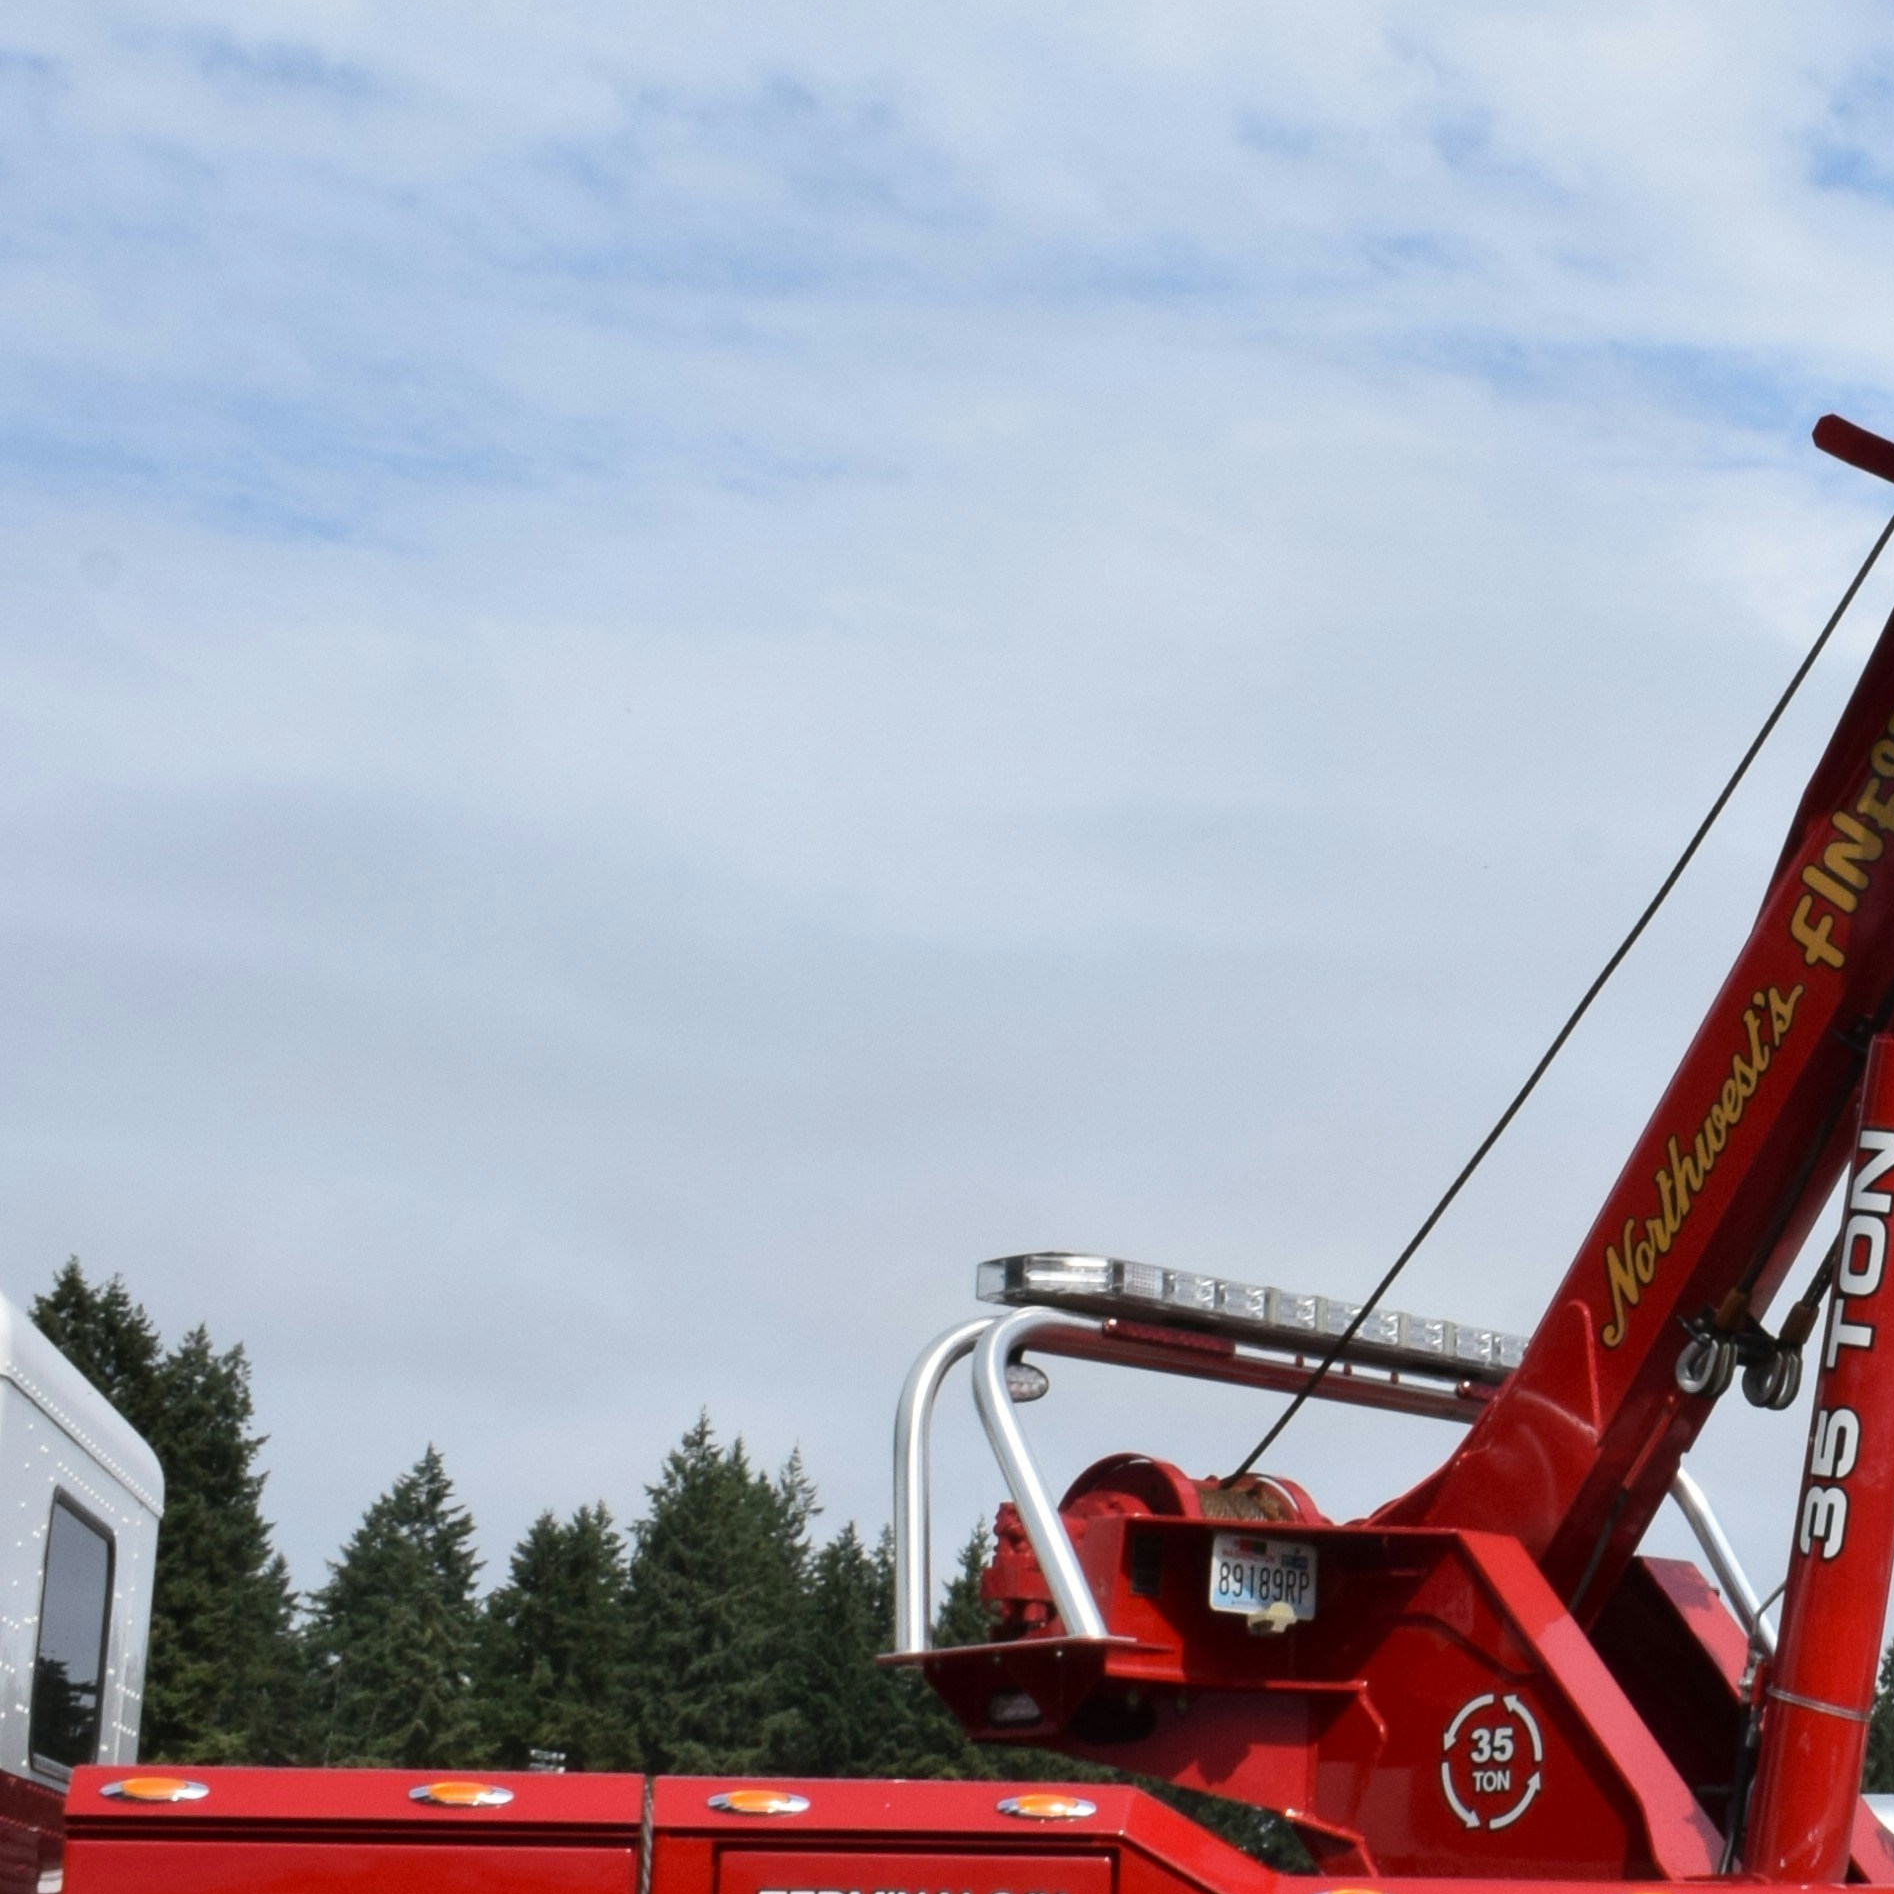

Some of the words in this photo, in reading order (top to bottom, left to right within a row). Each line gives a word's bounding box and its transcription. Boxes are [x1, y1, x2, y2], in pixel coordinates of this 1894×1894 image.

[1603, 984, 1804, 1347] Northwest's
[1799, 1407, 1861, 1560] 35
[1218, 1561, 1310, 1605] 89189RP
[1470, 1726, 1515, 1764] 35
[1472, 1769, 1511, 1793] TON
